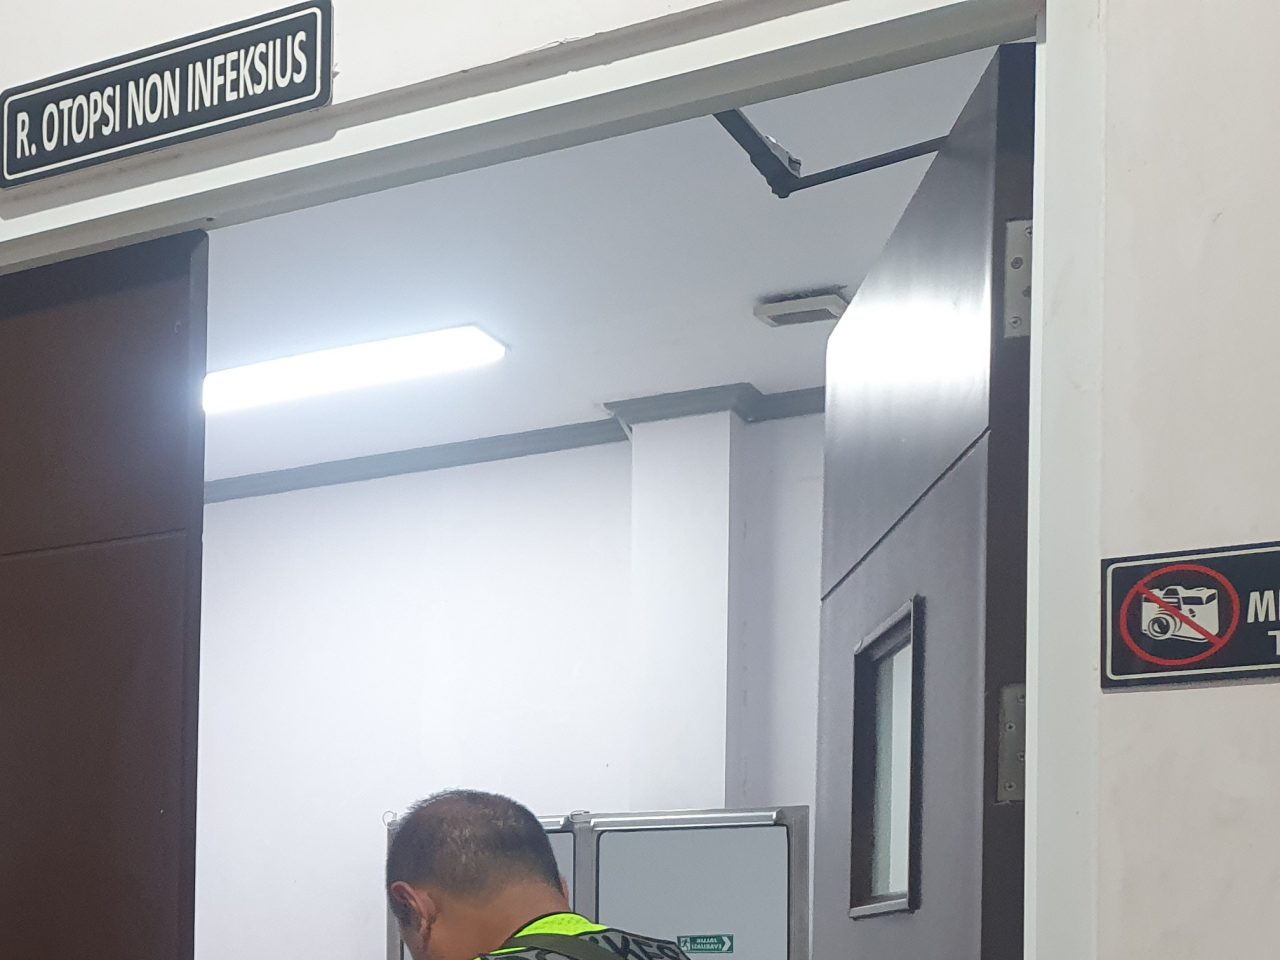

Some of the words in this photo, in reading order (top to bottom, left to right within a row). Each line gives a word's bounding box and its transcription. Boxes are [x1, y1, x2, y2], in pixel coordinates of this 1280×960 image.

[15, 112, 37, 159] R.
[41, 84, 121, 152] OTOPSI
[127, 67, 180, 129] NON
[187, 31, 308, 113] INFEKSIUS
